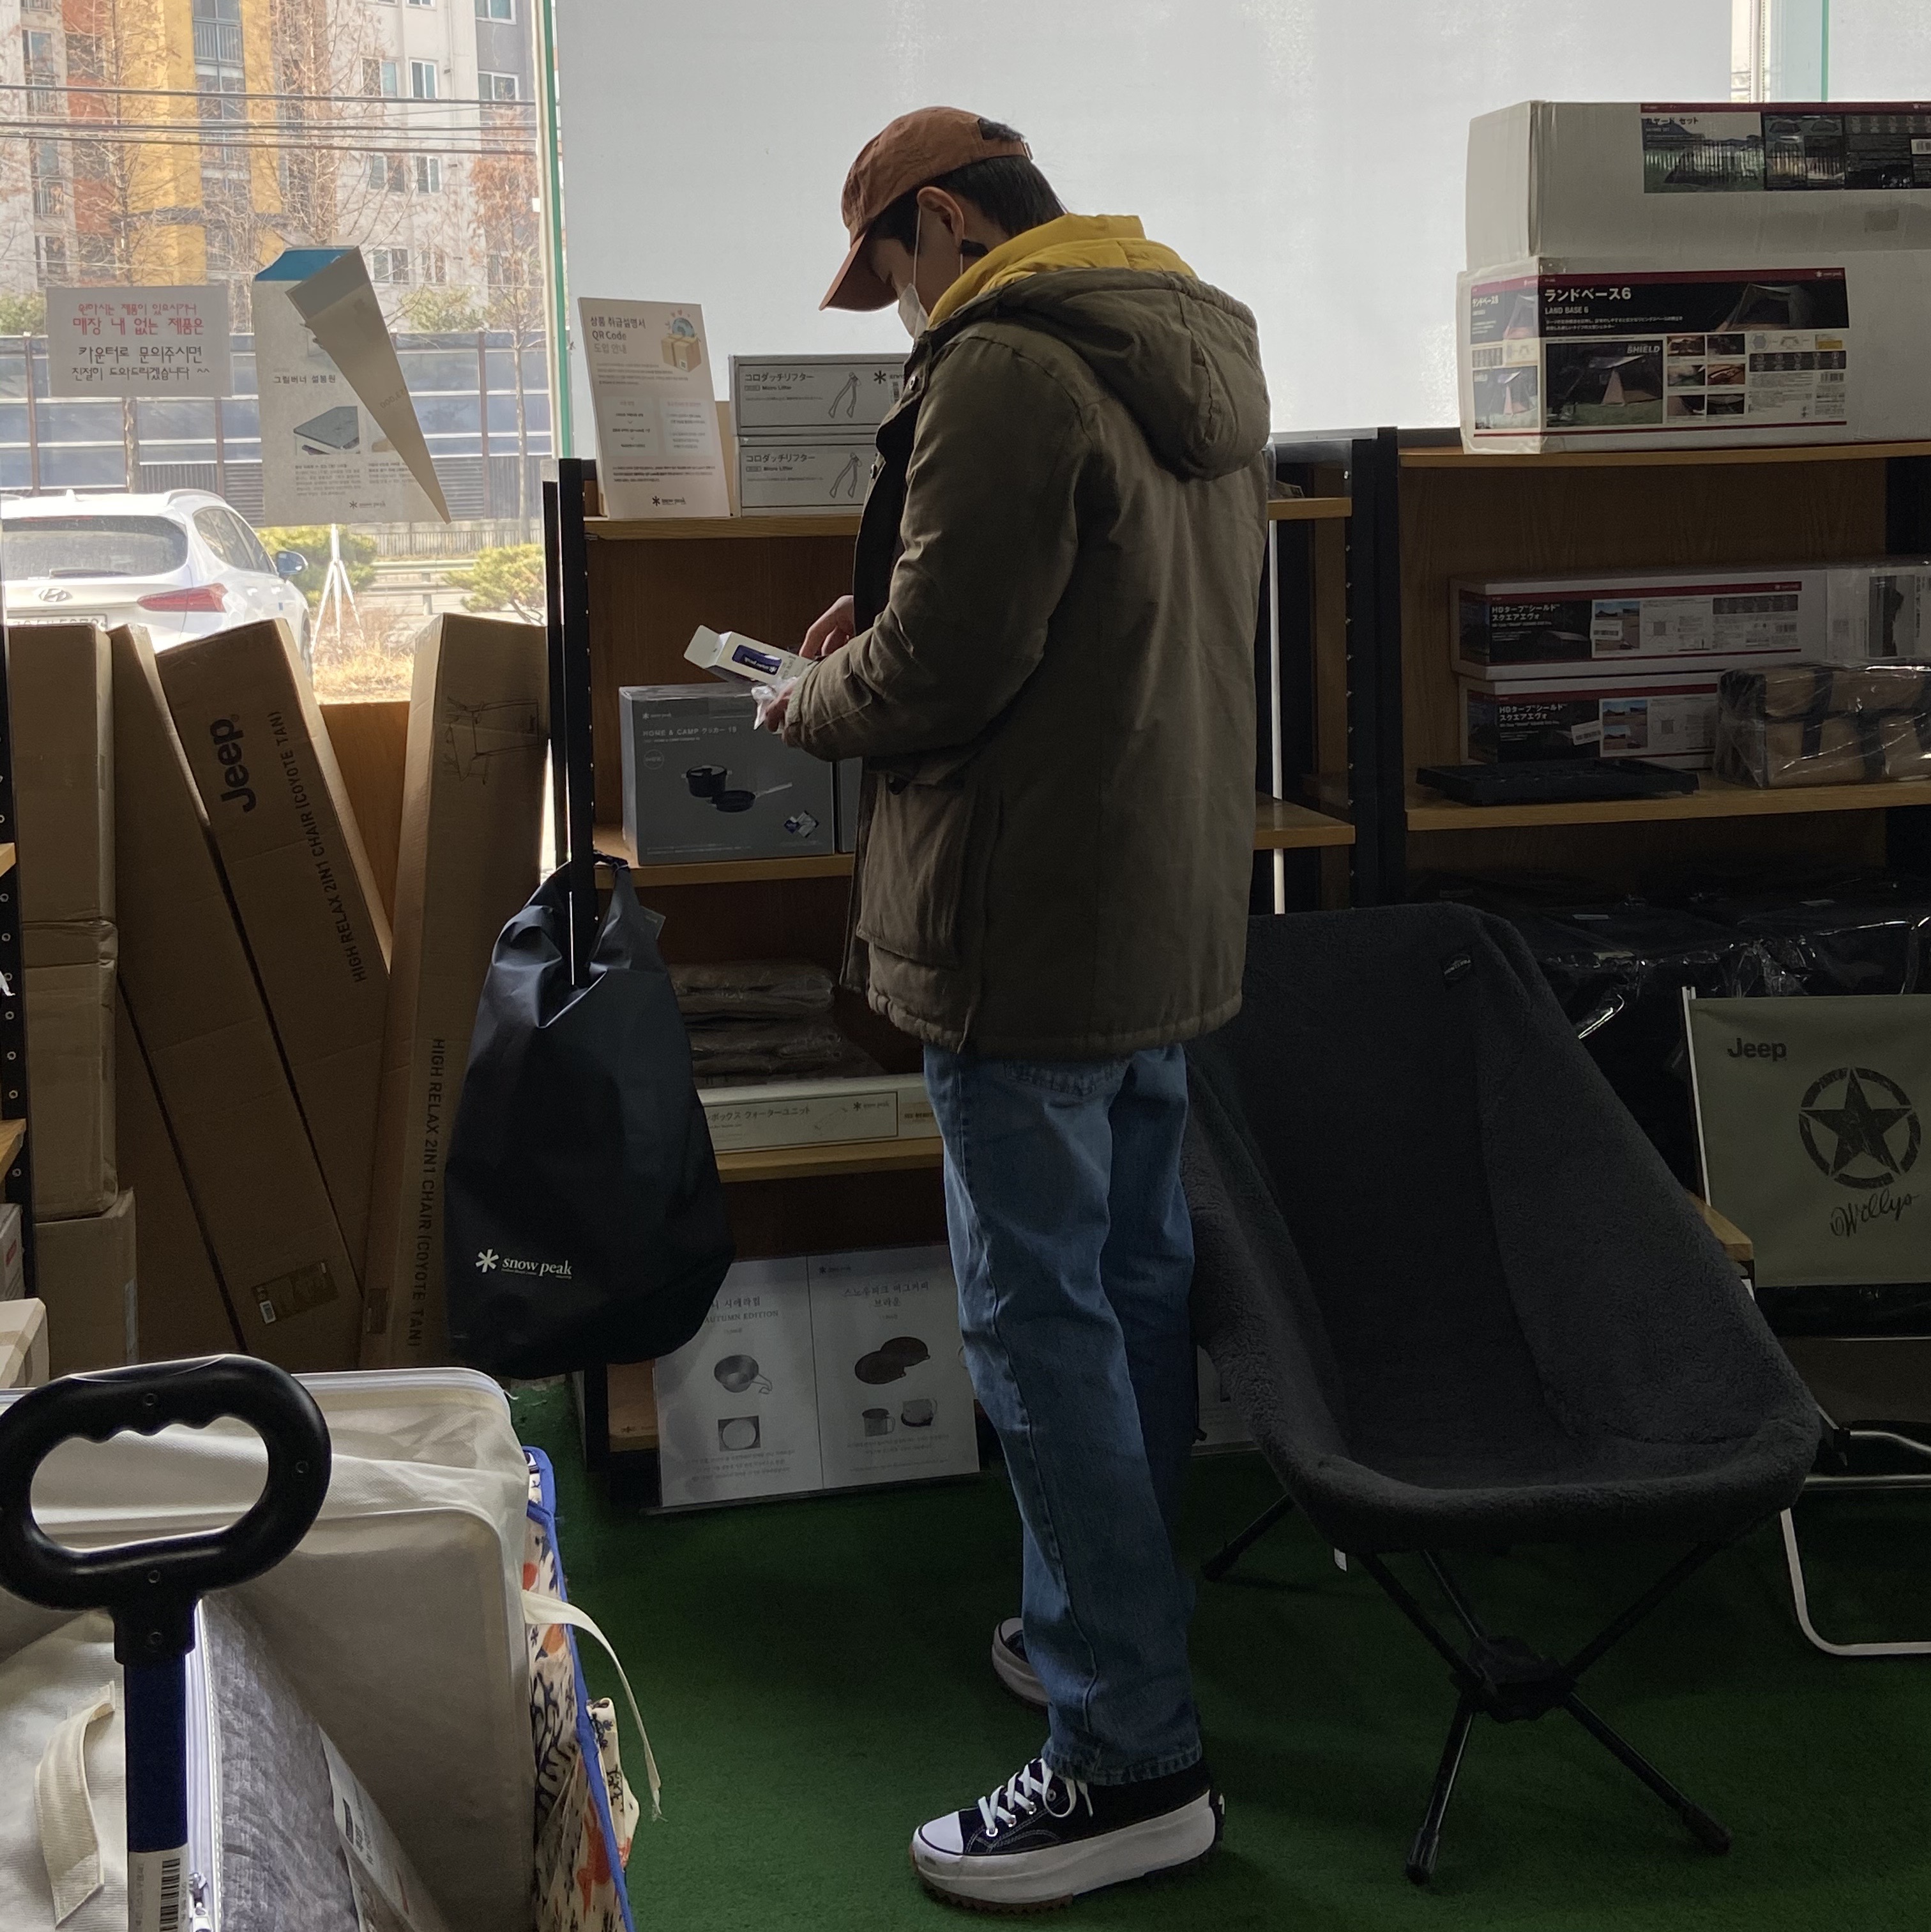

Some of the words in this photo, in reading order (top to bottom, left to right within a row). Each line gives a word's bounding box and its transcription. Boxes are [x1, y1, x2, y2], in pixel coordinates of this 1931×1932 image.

[1679, 116, 1699, 125] セット
[1545, 287, 1632, 303] ランドベース6
[1545, 307, 1563, 315] LAND
[1564, 306, 1582, 314] BASE
[72, 317, 102, 335] 매장
[110, 317, 126, 335] 내
[133, 317, 159, 335] 없는
[167, 317, 204, 335] 제품은
[590, 316, 606, 328] 상품
[592, 330, 605, 342] QR
[605, 331, 627, 342] Code
[79, 346, 130, 364] 카운터로
[139, 346, 202, 364] 문의주시면
[1627, 345, 1660, 354] SHIELD
[72, 367, 103, 381] 친절히
[109, 367, 190, 381] 도와드리겠습니다
[744, 372, 815, 383] コロダッチリフター
[745, 453, 815, 464] コロダッチリフター
[209, 718, 257, 814] Jeep
[300, 810, 325, 857] CHAIR
[315, 860, 337, 893] 2IN1
[327, 895, 354, 943] RELAX
[344, 945, 367, 983] HIGH
[430, 1038, 446, 1077] HIGH
[1727, 1037, 1787, 1062] Jeep
[426, 1081, 443, 1134] RELAX
[423, 1139, 438, 1173] 2IN1
[418, 1180, 435, 1231] CHAIR
[412, 1235, 432, 1300] (COYOTE
[502, 1258, 539, 1271] snow
[539, 1259, 573, 1277] peak
[704, 1313, 741, 1324] AUTUMN
[743, 1310, 779, 1320] EDITION
